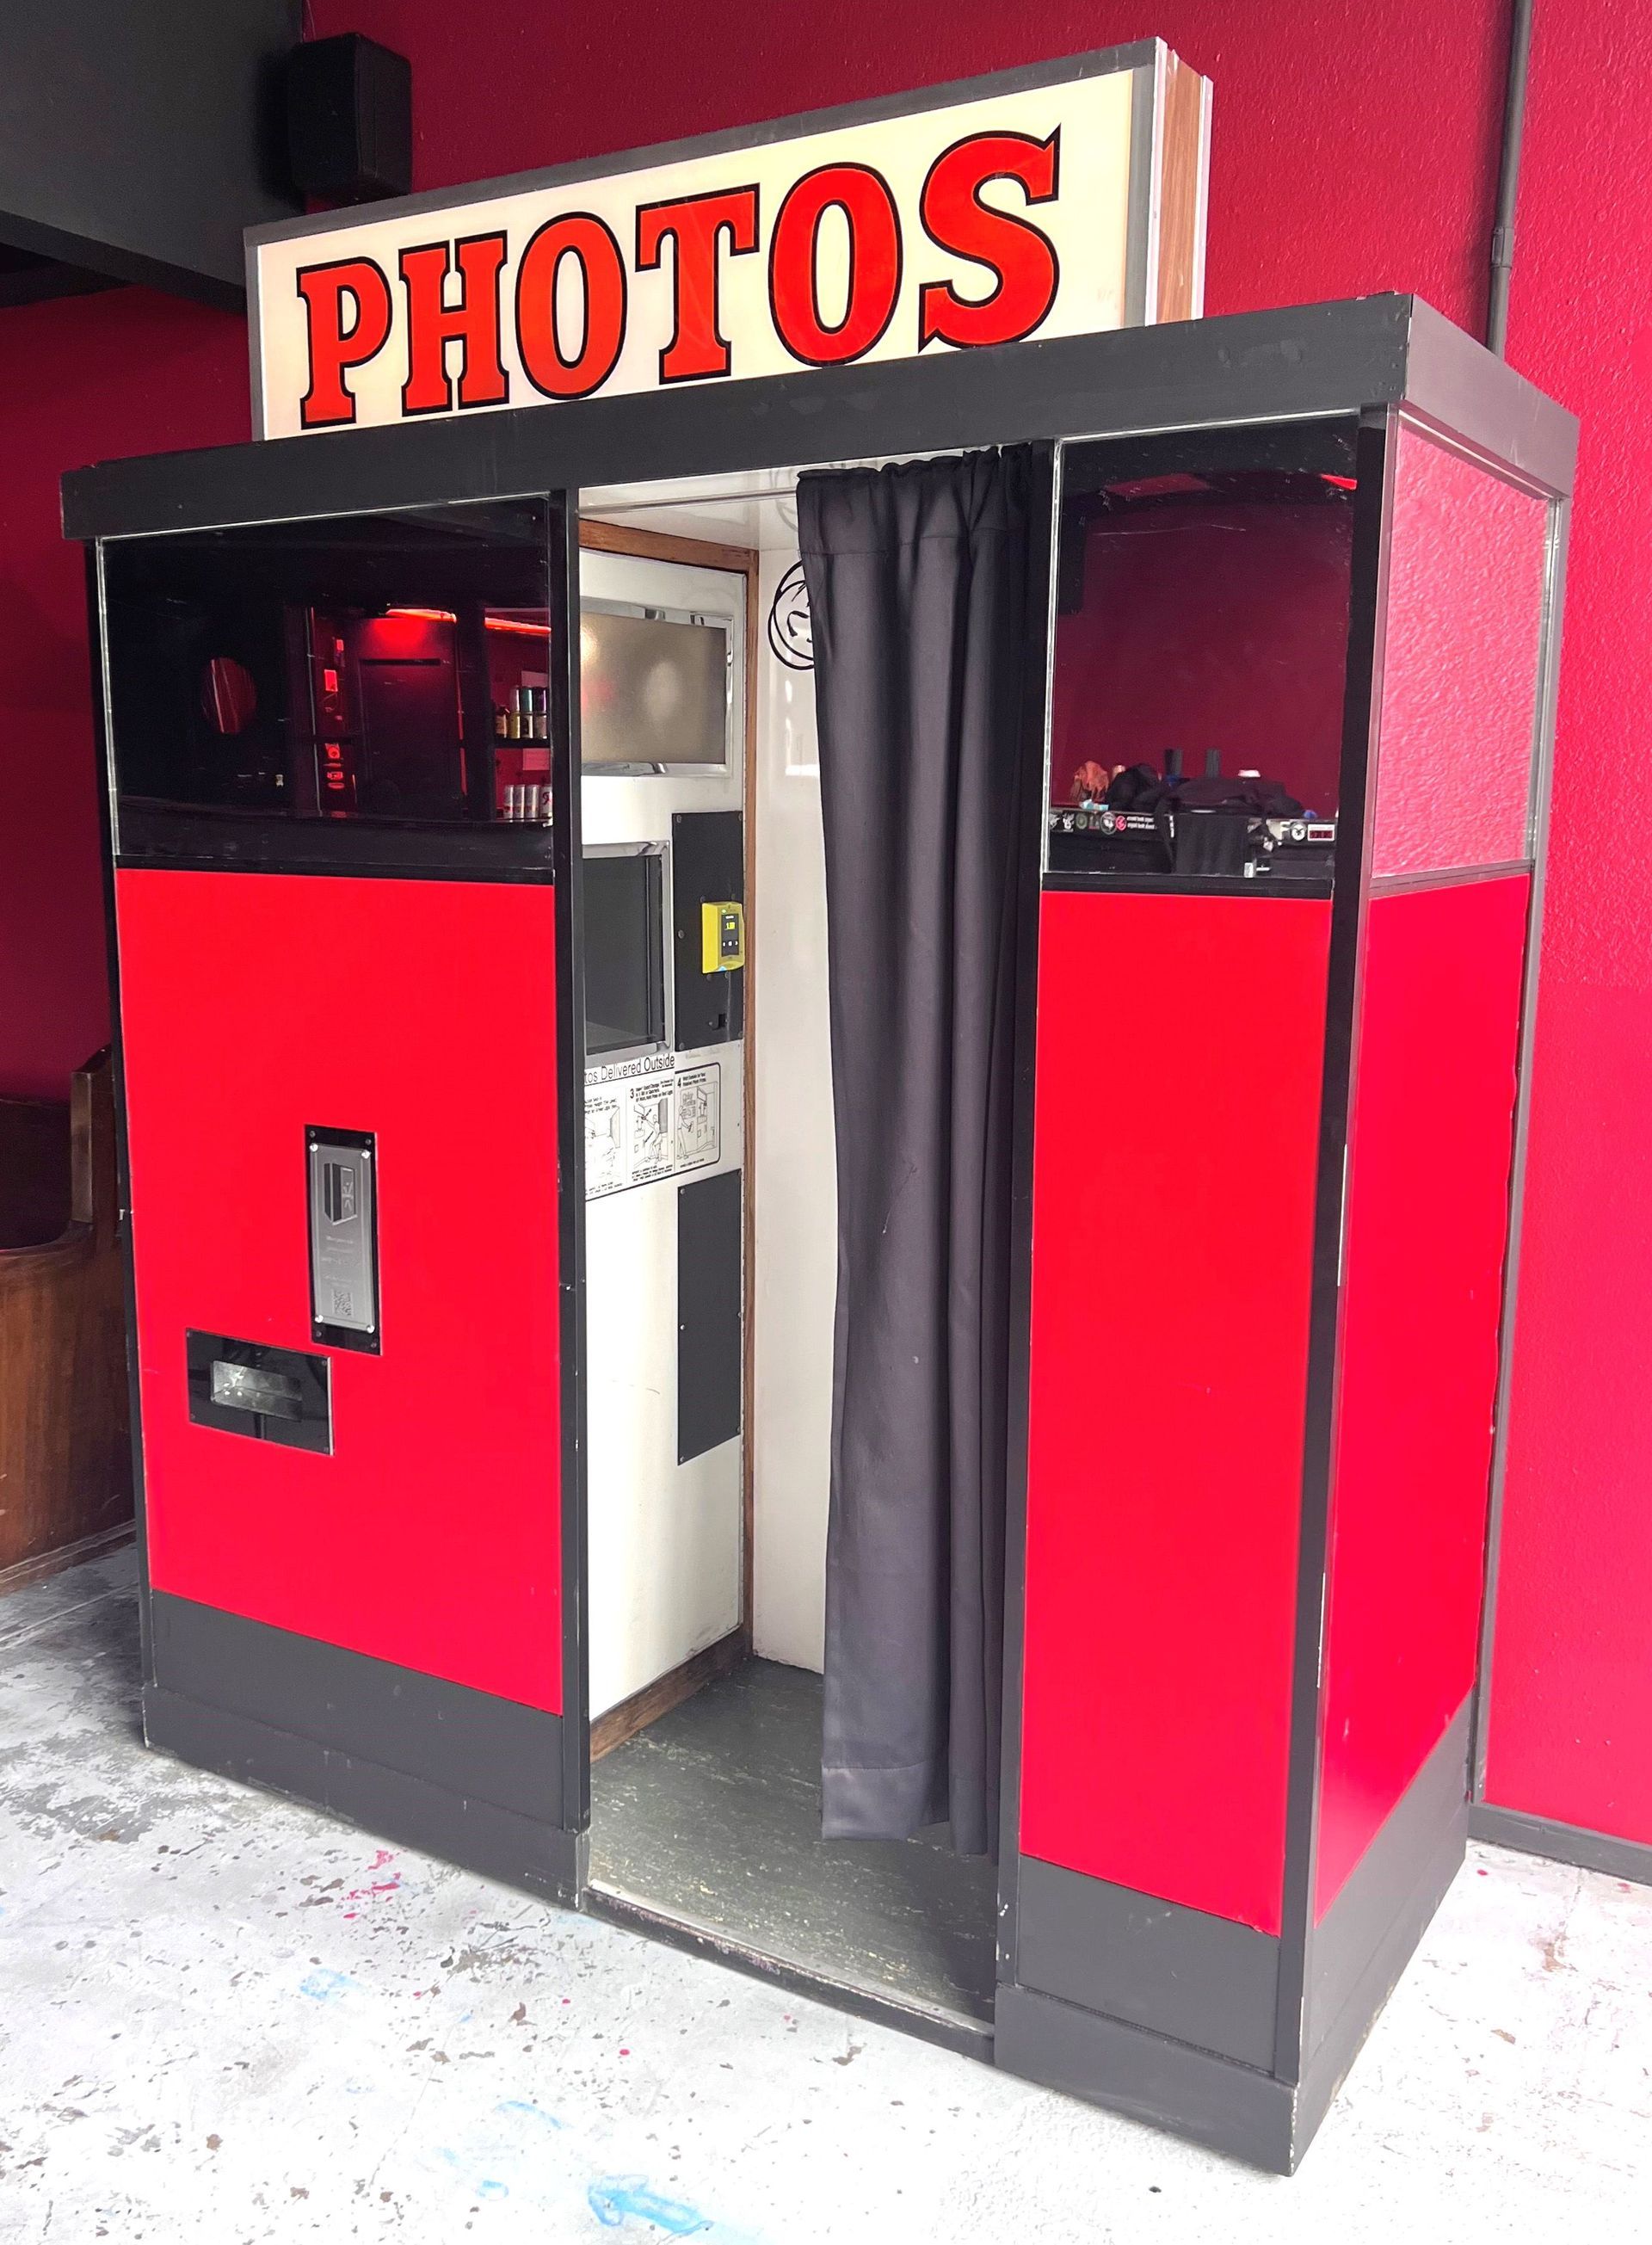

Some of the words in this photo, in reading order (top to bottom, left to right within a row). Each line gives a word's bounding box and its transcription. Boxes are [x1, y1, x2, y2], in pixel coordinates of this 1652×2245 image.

[296, 125, 1062, 429] PHOTOS
[601, 1058, 642, 1081] Delivered
[644, 1053, 675, 1072] Outside
[677, 1077, 681, 1089] 4
[630, 1088, 635, 1100] 3
